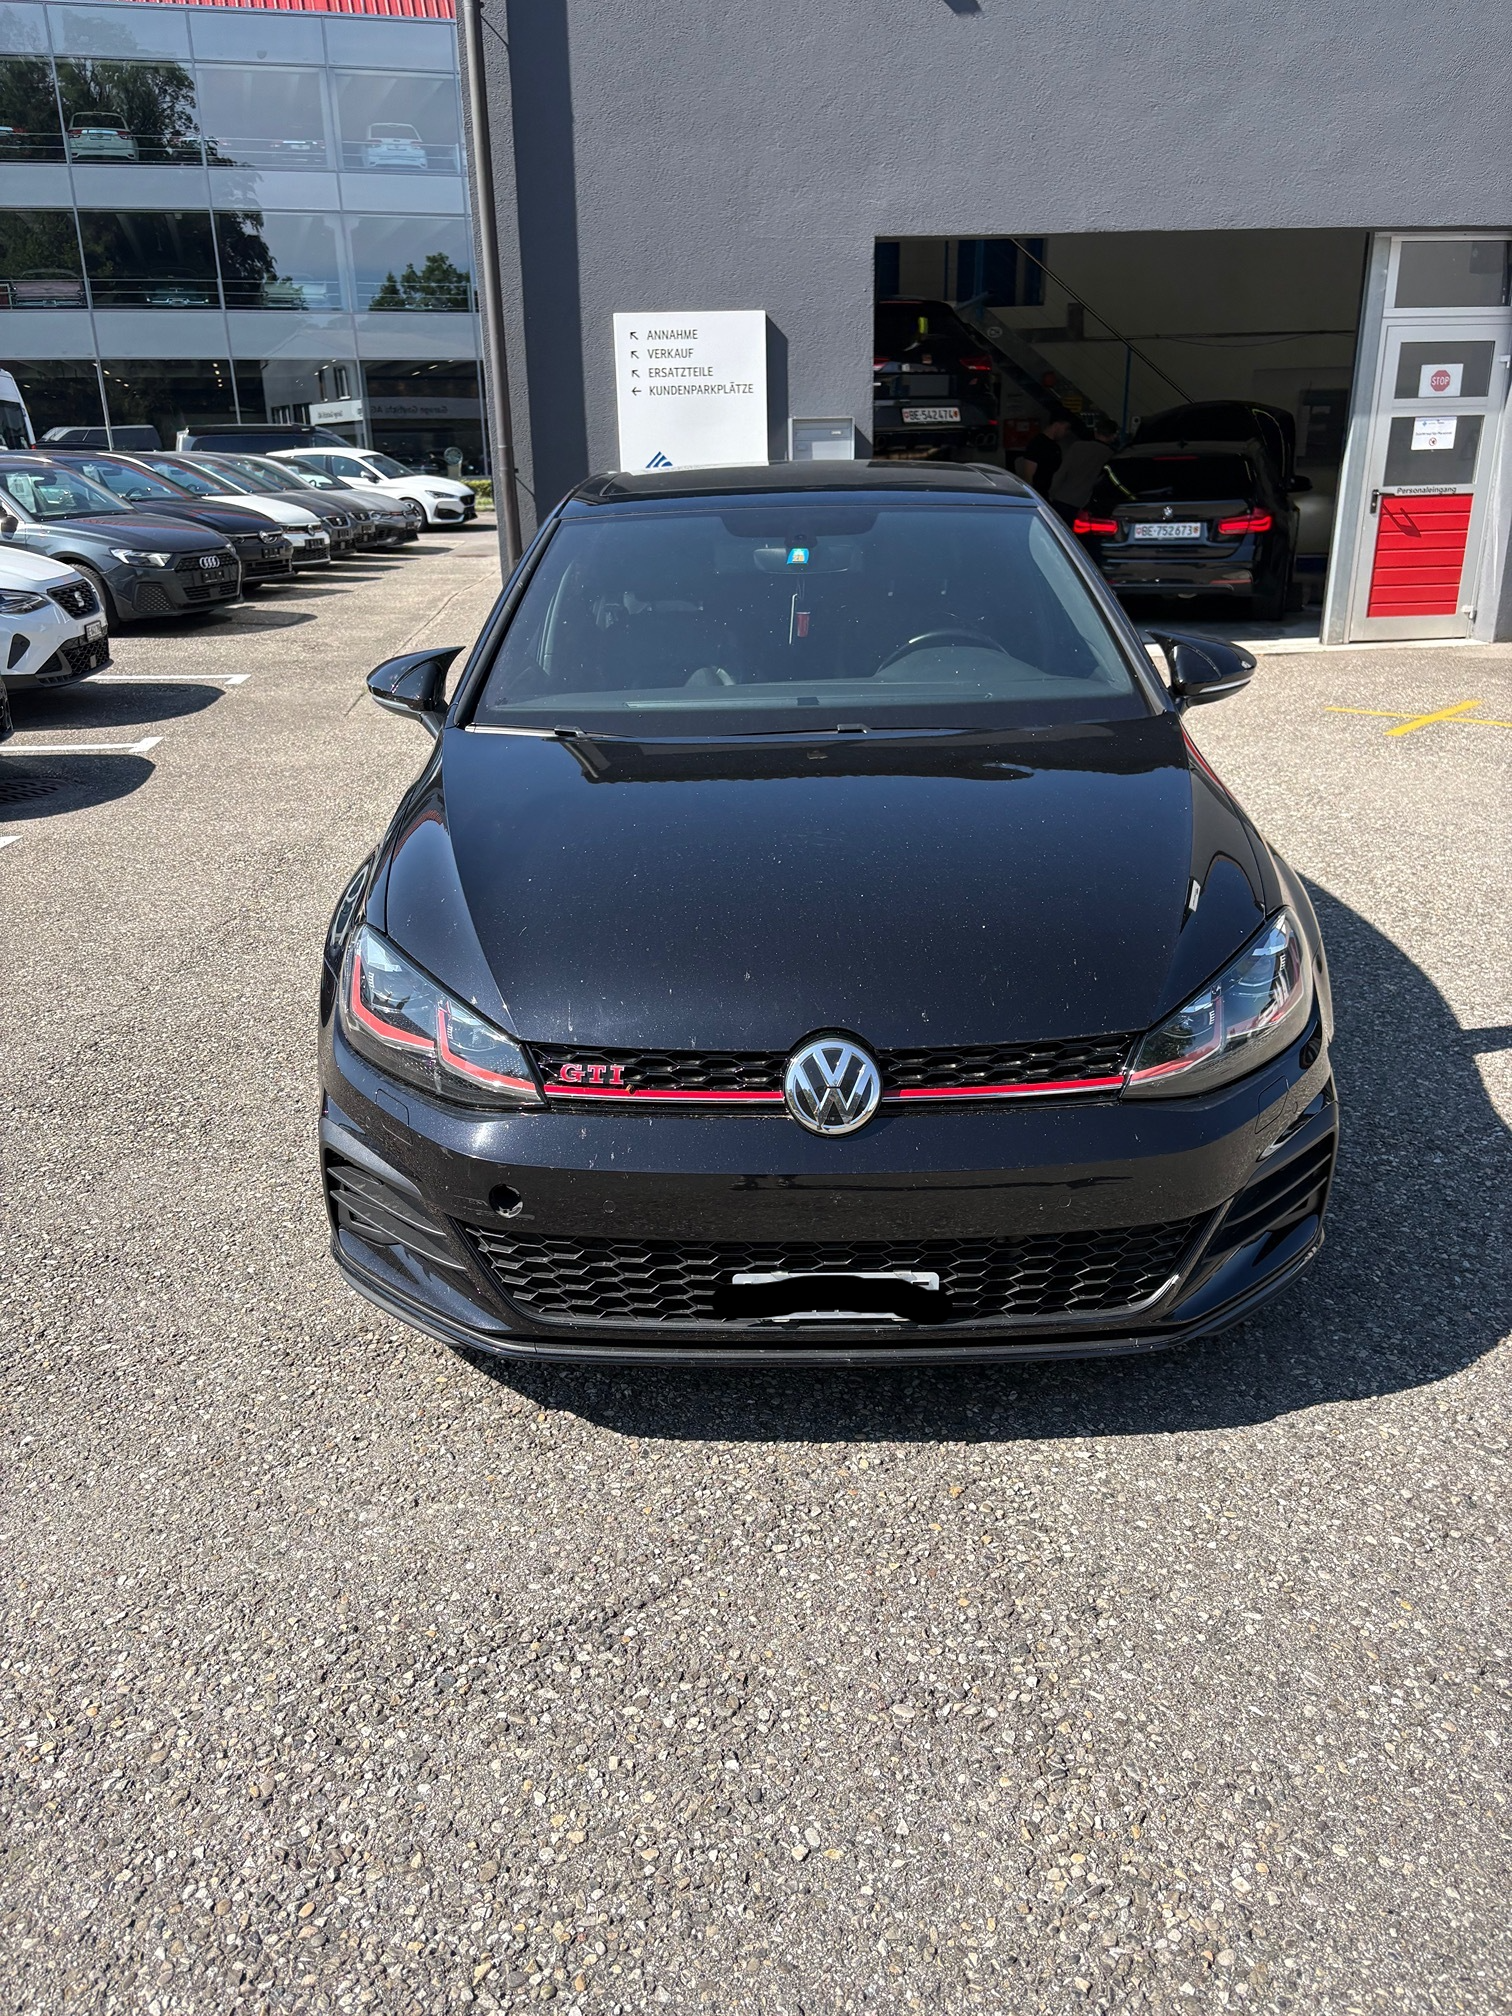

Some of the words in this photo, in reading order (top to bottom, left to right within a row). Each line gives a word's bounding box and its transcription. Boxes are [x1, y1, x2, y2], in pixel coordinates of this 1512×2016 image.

[647, 329, 698, 340] ANNAHME
[647, 348, 694, 359] VERKAUF
[648, 366, 714, 378] ERSATZTEILE
[1431, 376, 1450, 386] STOP
[649, 382, 754, 396] KUNDENPARKPLÄTZE
[1396, 486, 1457, 495] Personaleingang
[559, 1063, 625, 1085] GTI
